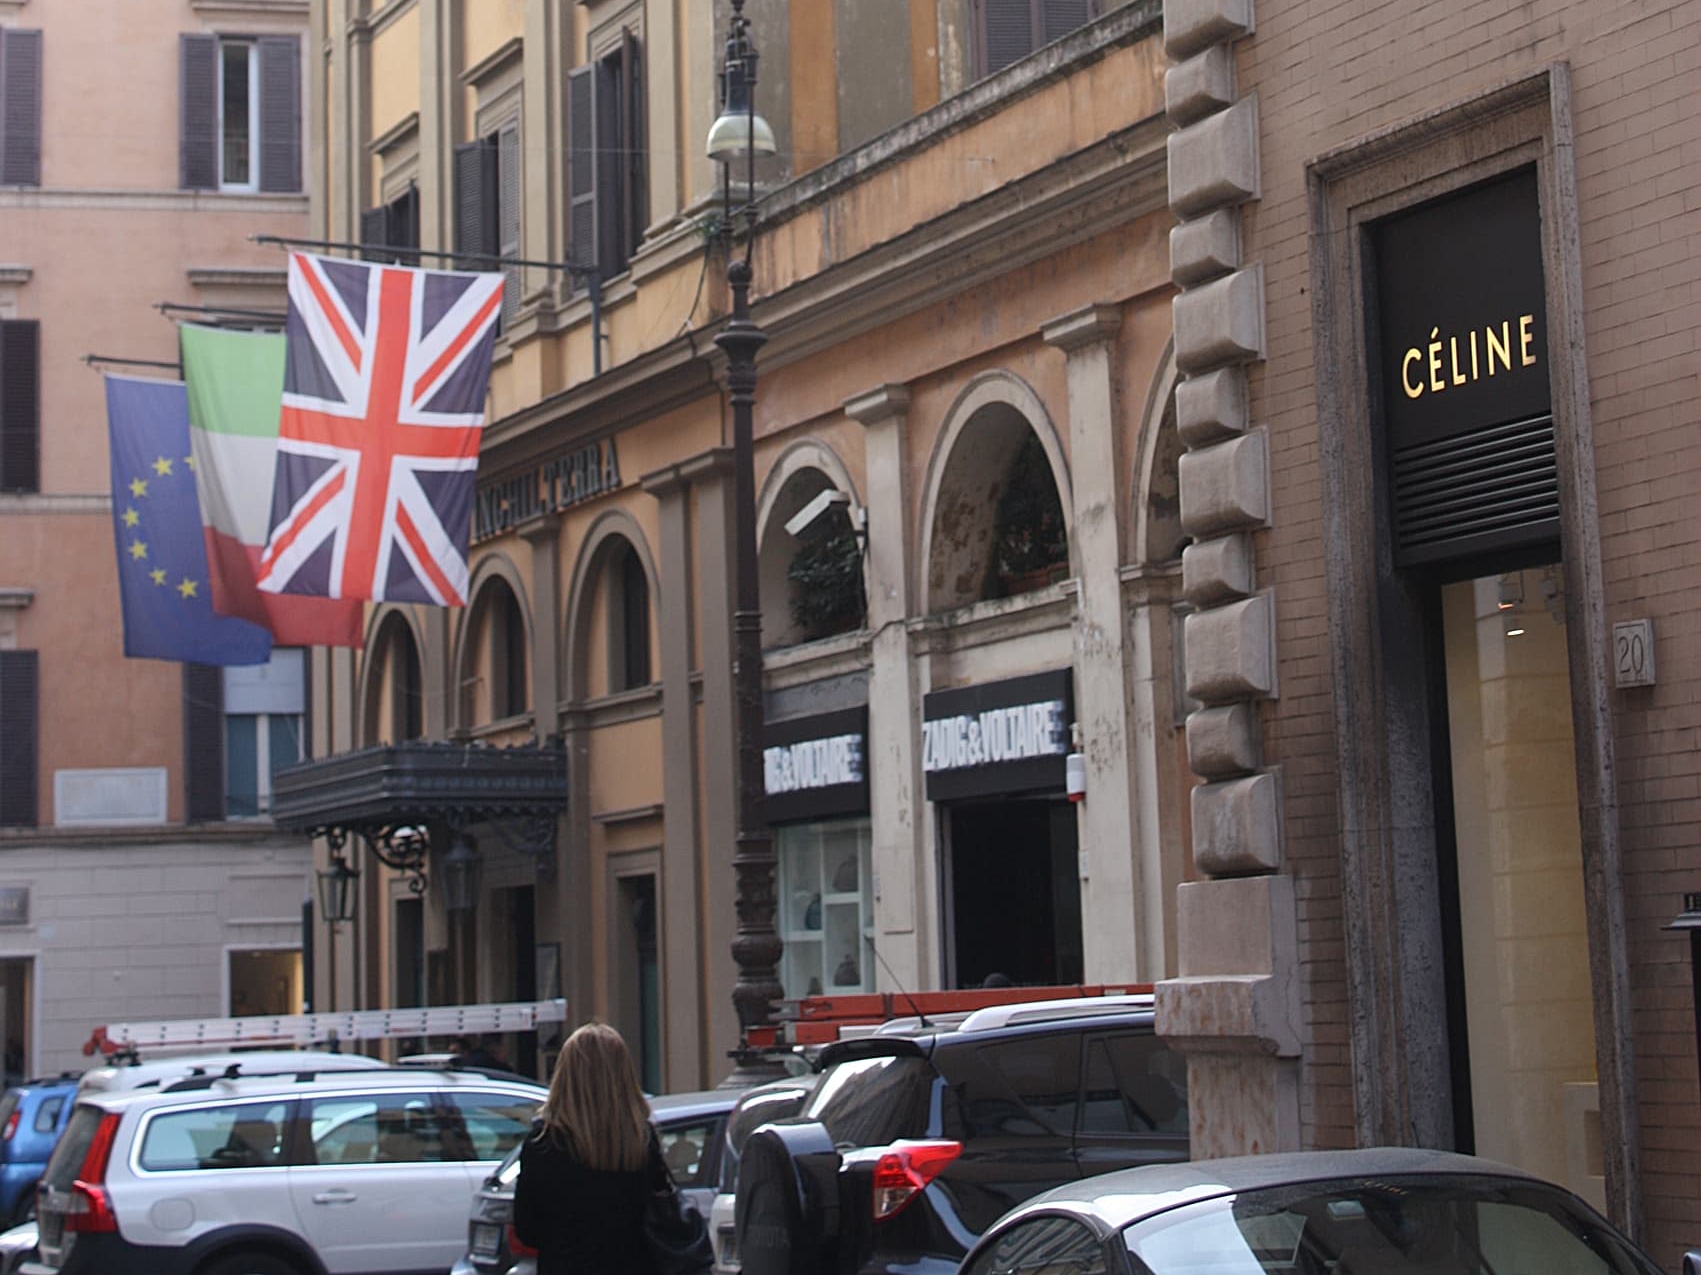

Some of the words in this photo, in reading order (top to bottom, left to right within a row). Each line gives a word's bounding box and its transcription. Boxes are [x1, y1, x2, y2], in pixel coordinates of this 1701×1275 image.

[1401, 314, 1537, 399] CÉLINE
[1617, 633, 1645, 675] 20
[921, 700, 1065, 772] ZADIG&VOLTAIRE
